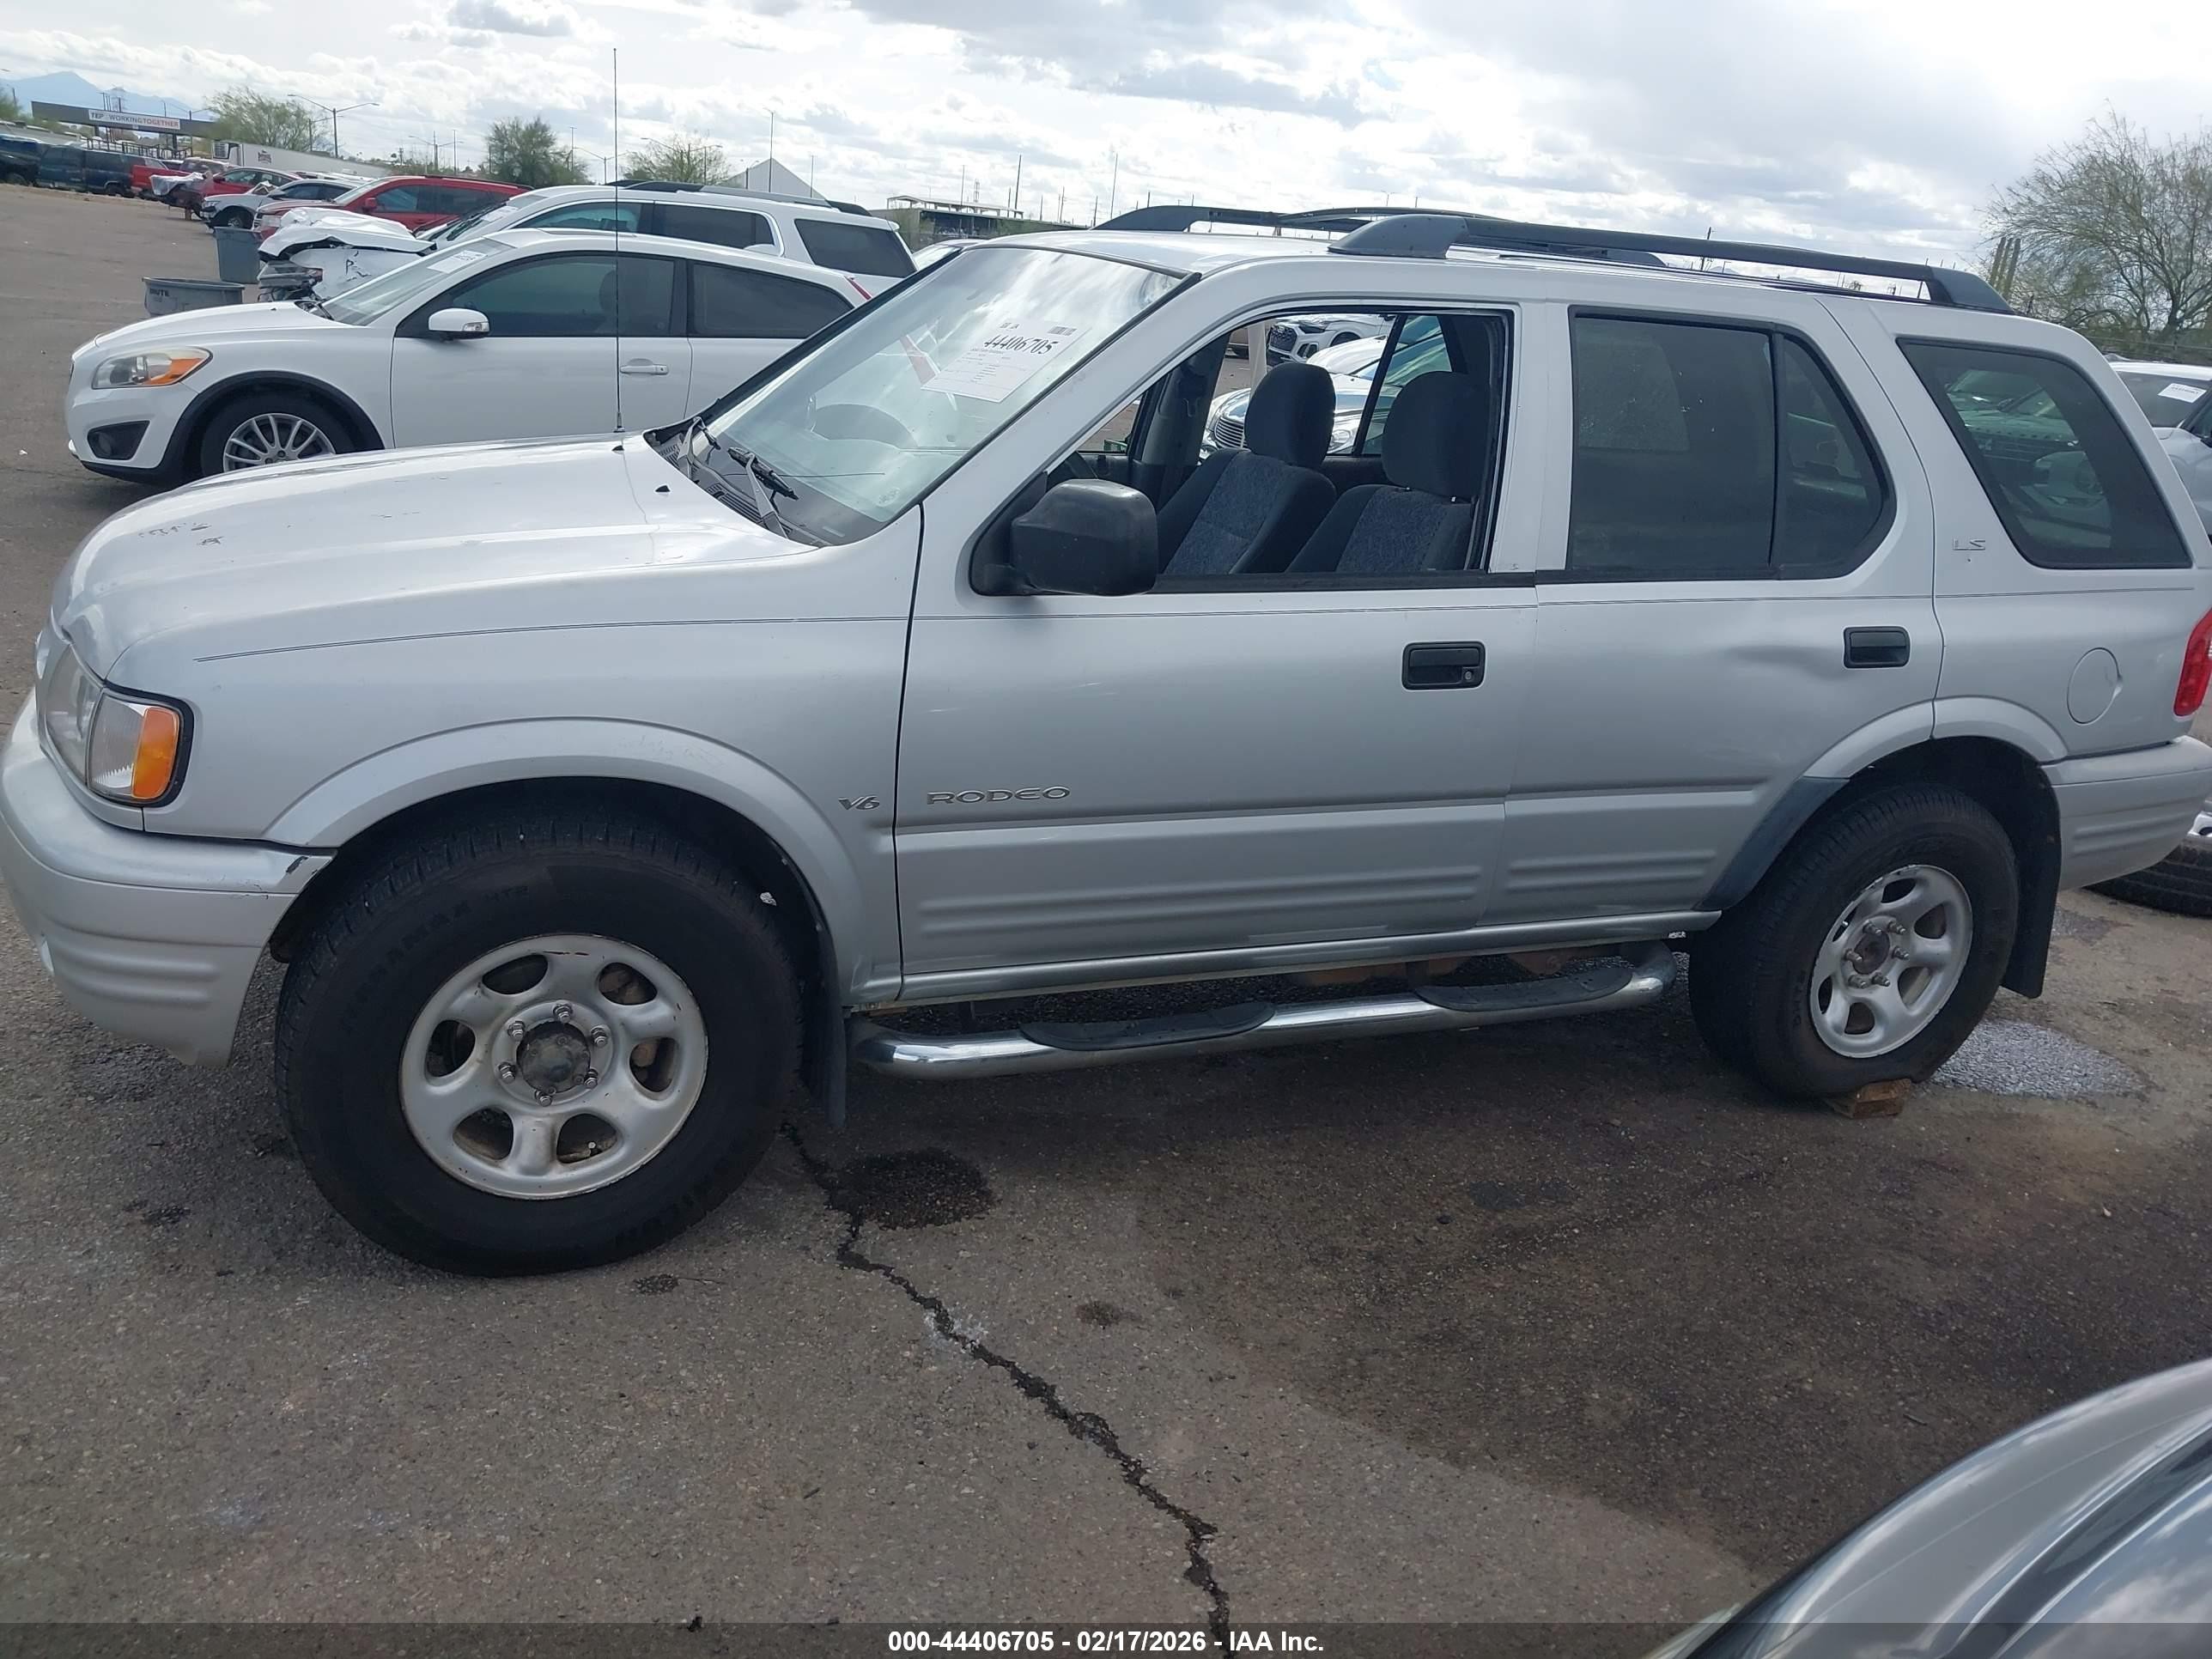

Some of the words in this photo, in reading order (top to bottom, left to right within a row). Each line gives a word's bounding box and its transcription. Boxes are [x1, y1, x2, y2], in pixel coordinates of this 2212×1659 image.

[984, 335, 1060, 355] 44406705
[1952, 538, 1986, 551] LS
[838, 795, 880, 811] V6
[927, 785, 1071, 805] RODEO
